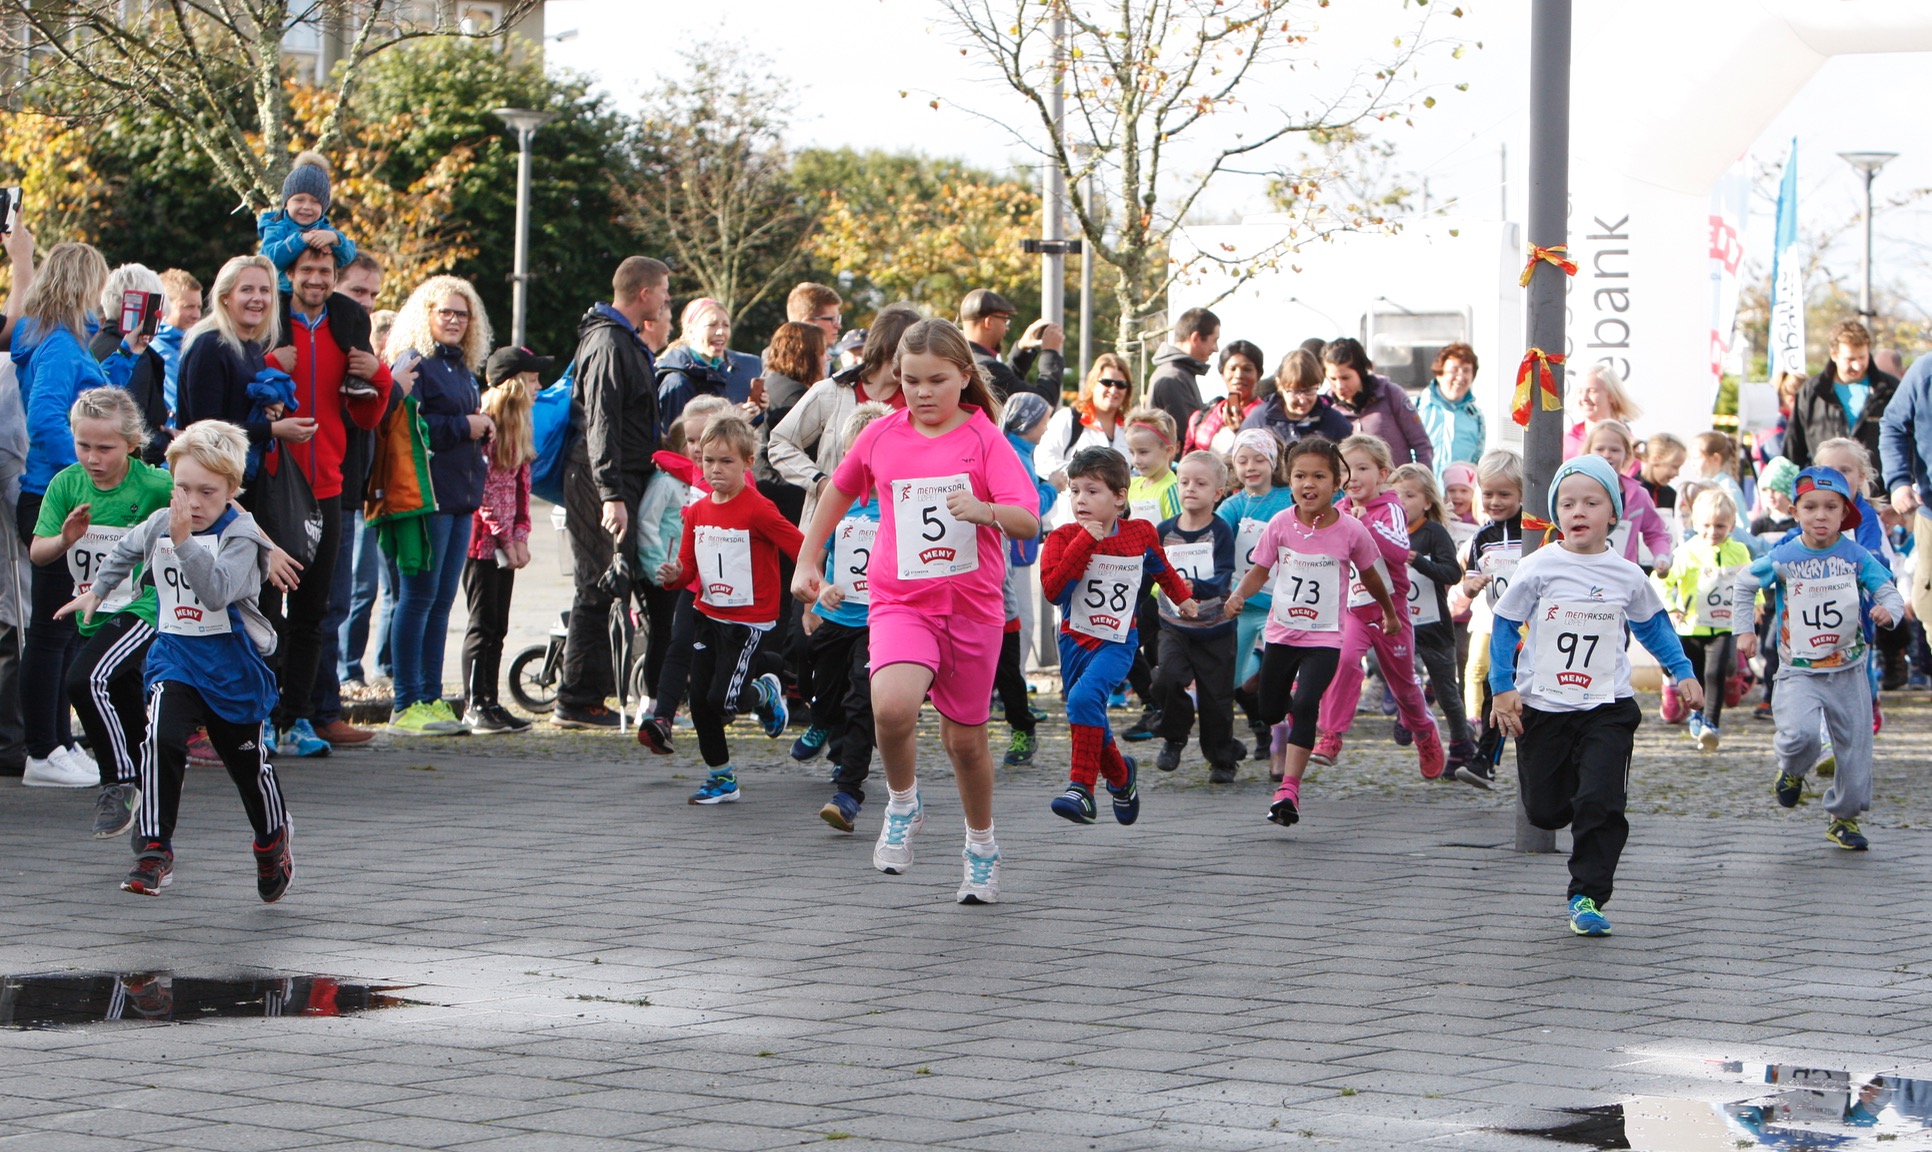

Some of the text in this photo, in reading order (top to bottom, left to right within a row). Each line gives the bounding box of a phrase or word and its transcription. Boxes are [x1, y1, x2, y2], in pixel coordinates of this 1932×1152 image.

[1586, 214, 1630, 381] ebank
[917, 483, 967, 495] MENYAKSDAL
[922, 506, 946, 541] 5
[923, 549, 953, 561] MENY
[718, 553, 723, 578] 1
[711, 585, 731, 593] MENY
[1291, 576, 1320, 605] 73
[1084, 580, 1129, 613] 58
[176, 609, 200, 618] MENY
[1291, 608, 1316, 618] MENY
[1565, 611, 1615, 620] MENYAKSDAL
[1802, 600, 1843, 630] 45
[1092, 616, 1118, 626] MENY
[1813, 636, 1838, 645] MENY
[1557, 632, 1599, 670] 97
[1560, 675, 1589, 684] MENY
